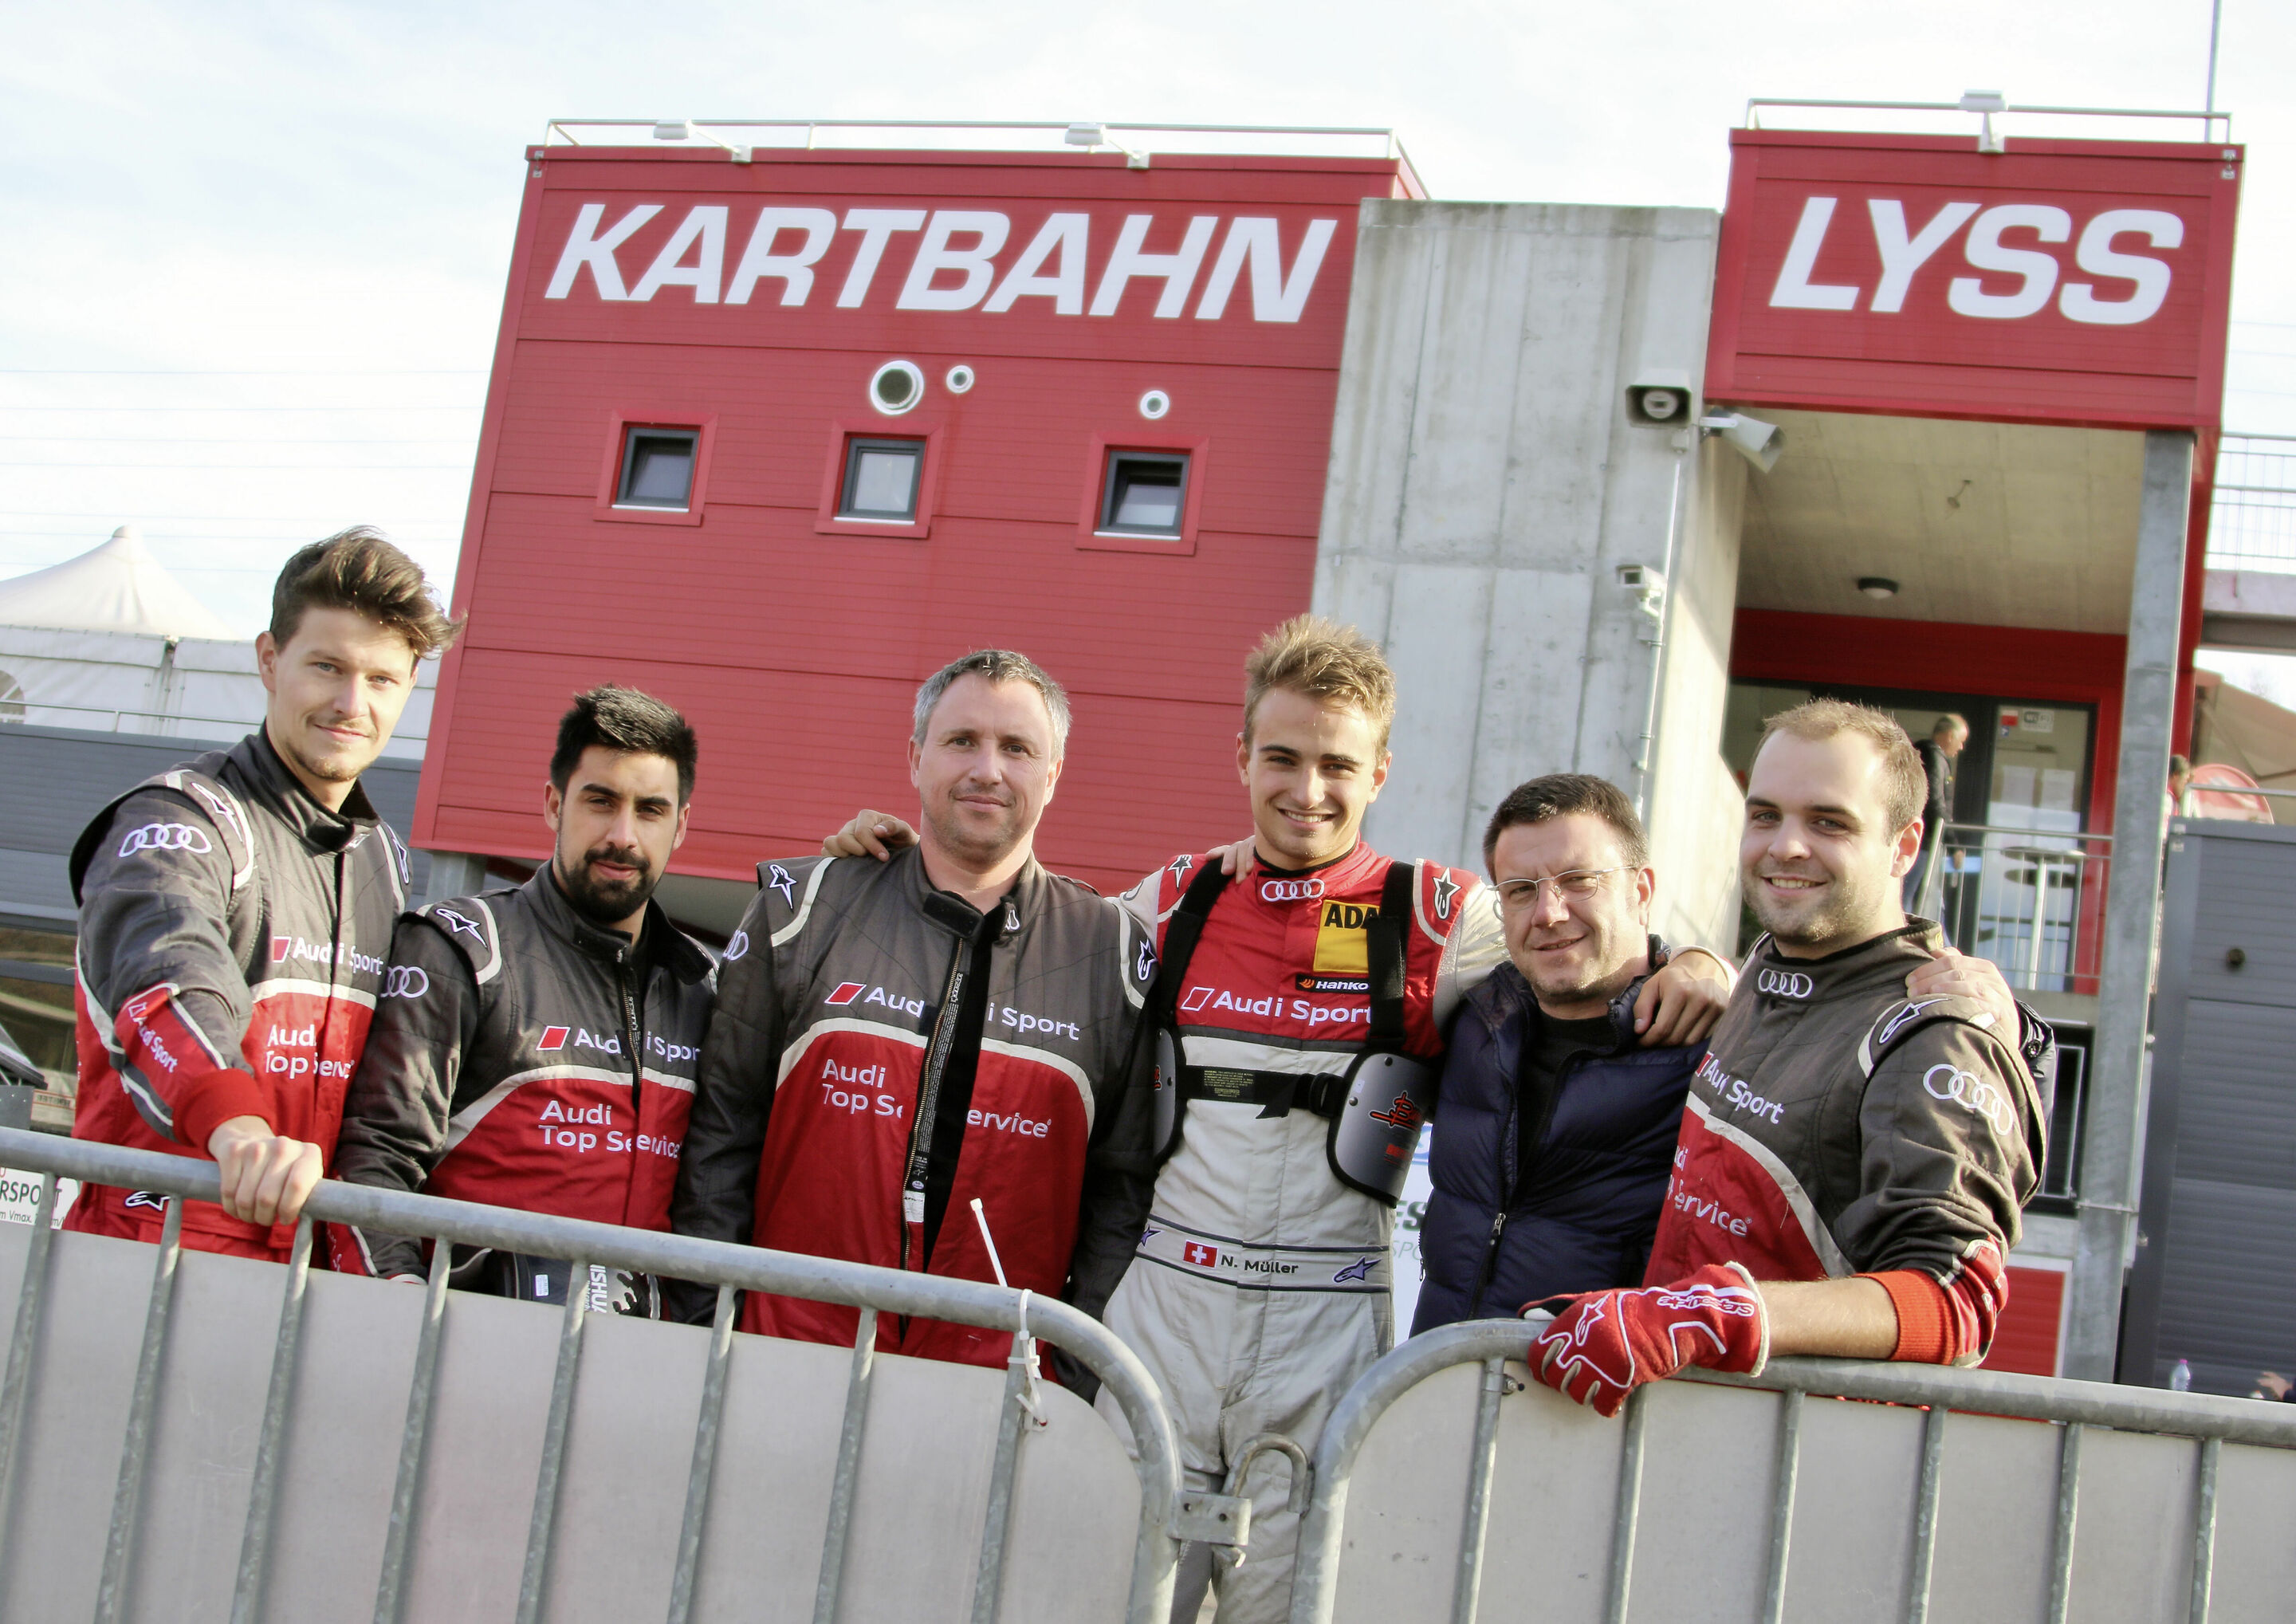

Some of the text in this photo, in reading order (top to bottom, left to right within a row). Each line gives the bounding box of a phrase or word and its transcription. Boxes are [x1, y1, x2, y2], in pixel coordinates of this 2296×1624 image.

[544, 203, 1337, 323] KARTBAHN
[1768, 196, 2184, 324] LYSS
[1324, 904, 1380, 929] ADA
[293, 937, 345, 964] Audi
[1315, 981, 1370, 990] Hanko
[1212, 991, 1371, 1026] Audi Sport
[1001, 1007, 1080, 1040] Sport
[654, 1036, 701, 1062] Spor
[822, 1059, 886, 1088] Audi
[540, 1100, 612, 1125] Audi
[822, 1083, 869, 1115] Top
[1726, 1079, 1784, 1124] Sport
[538, 1124, 597, 1153] Top
[1221, 1255, 1299, 1274] N. Müller
